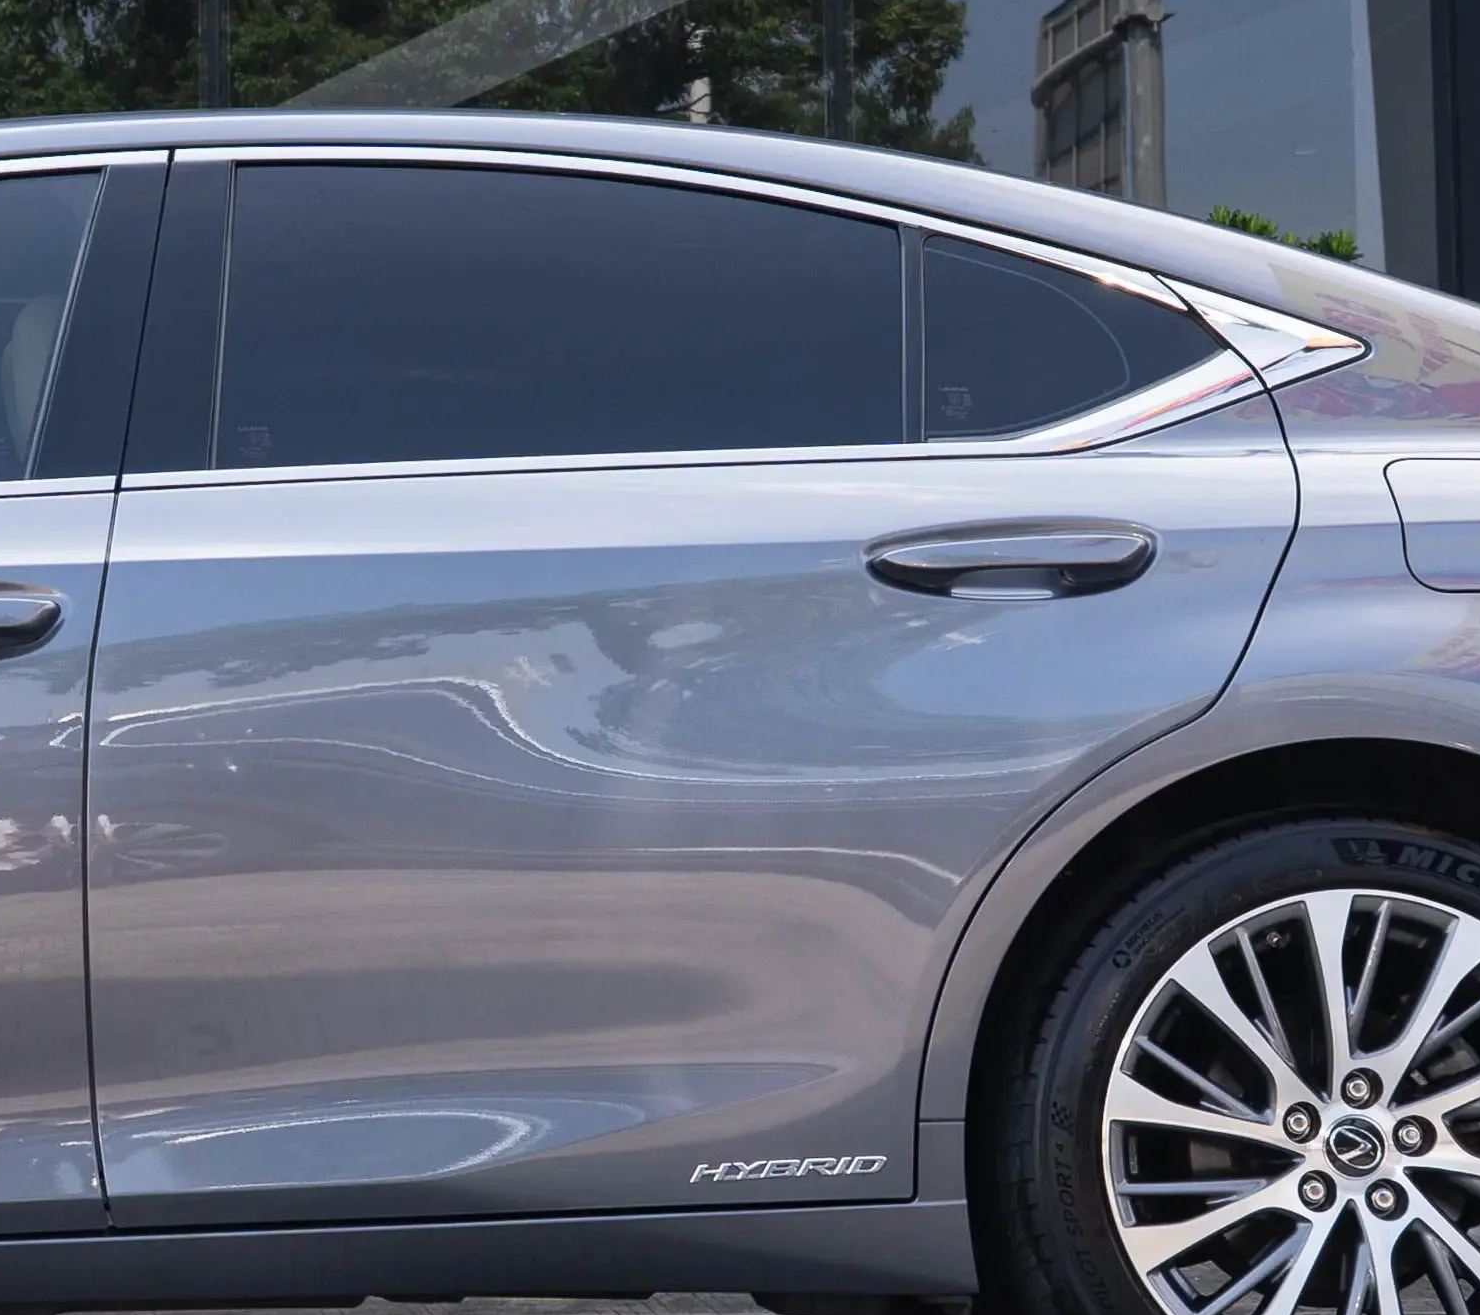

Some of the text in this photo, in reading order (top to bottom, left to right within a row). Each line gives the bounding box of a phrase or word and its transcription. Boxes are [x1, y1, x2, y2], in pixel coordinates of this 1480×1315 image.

[690, 1155, 888, 1183] HYBRID
[1053, 1158, 1084, 1236] SPORT
[1075, 1248, 1115, 1310] PILOT
